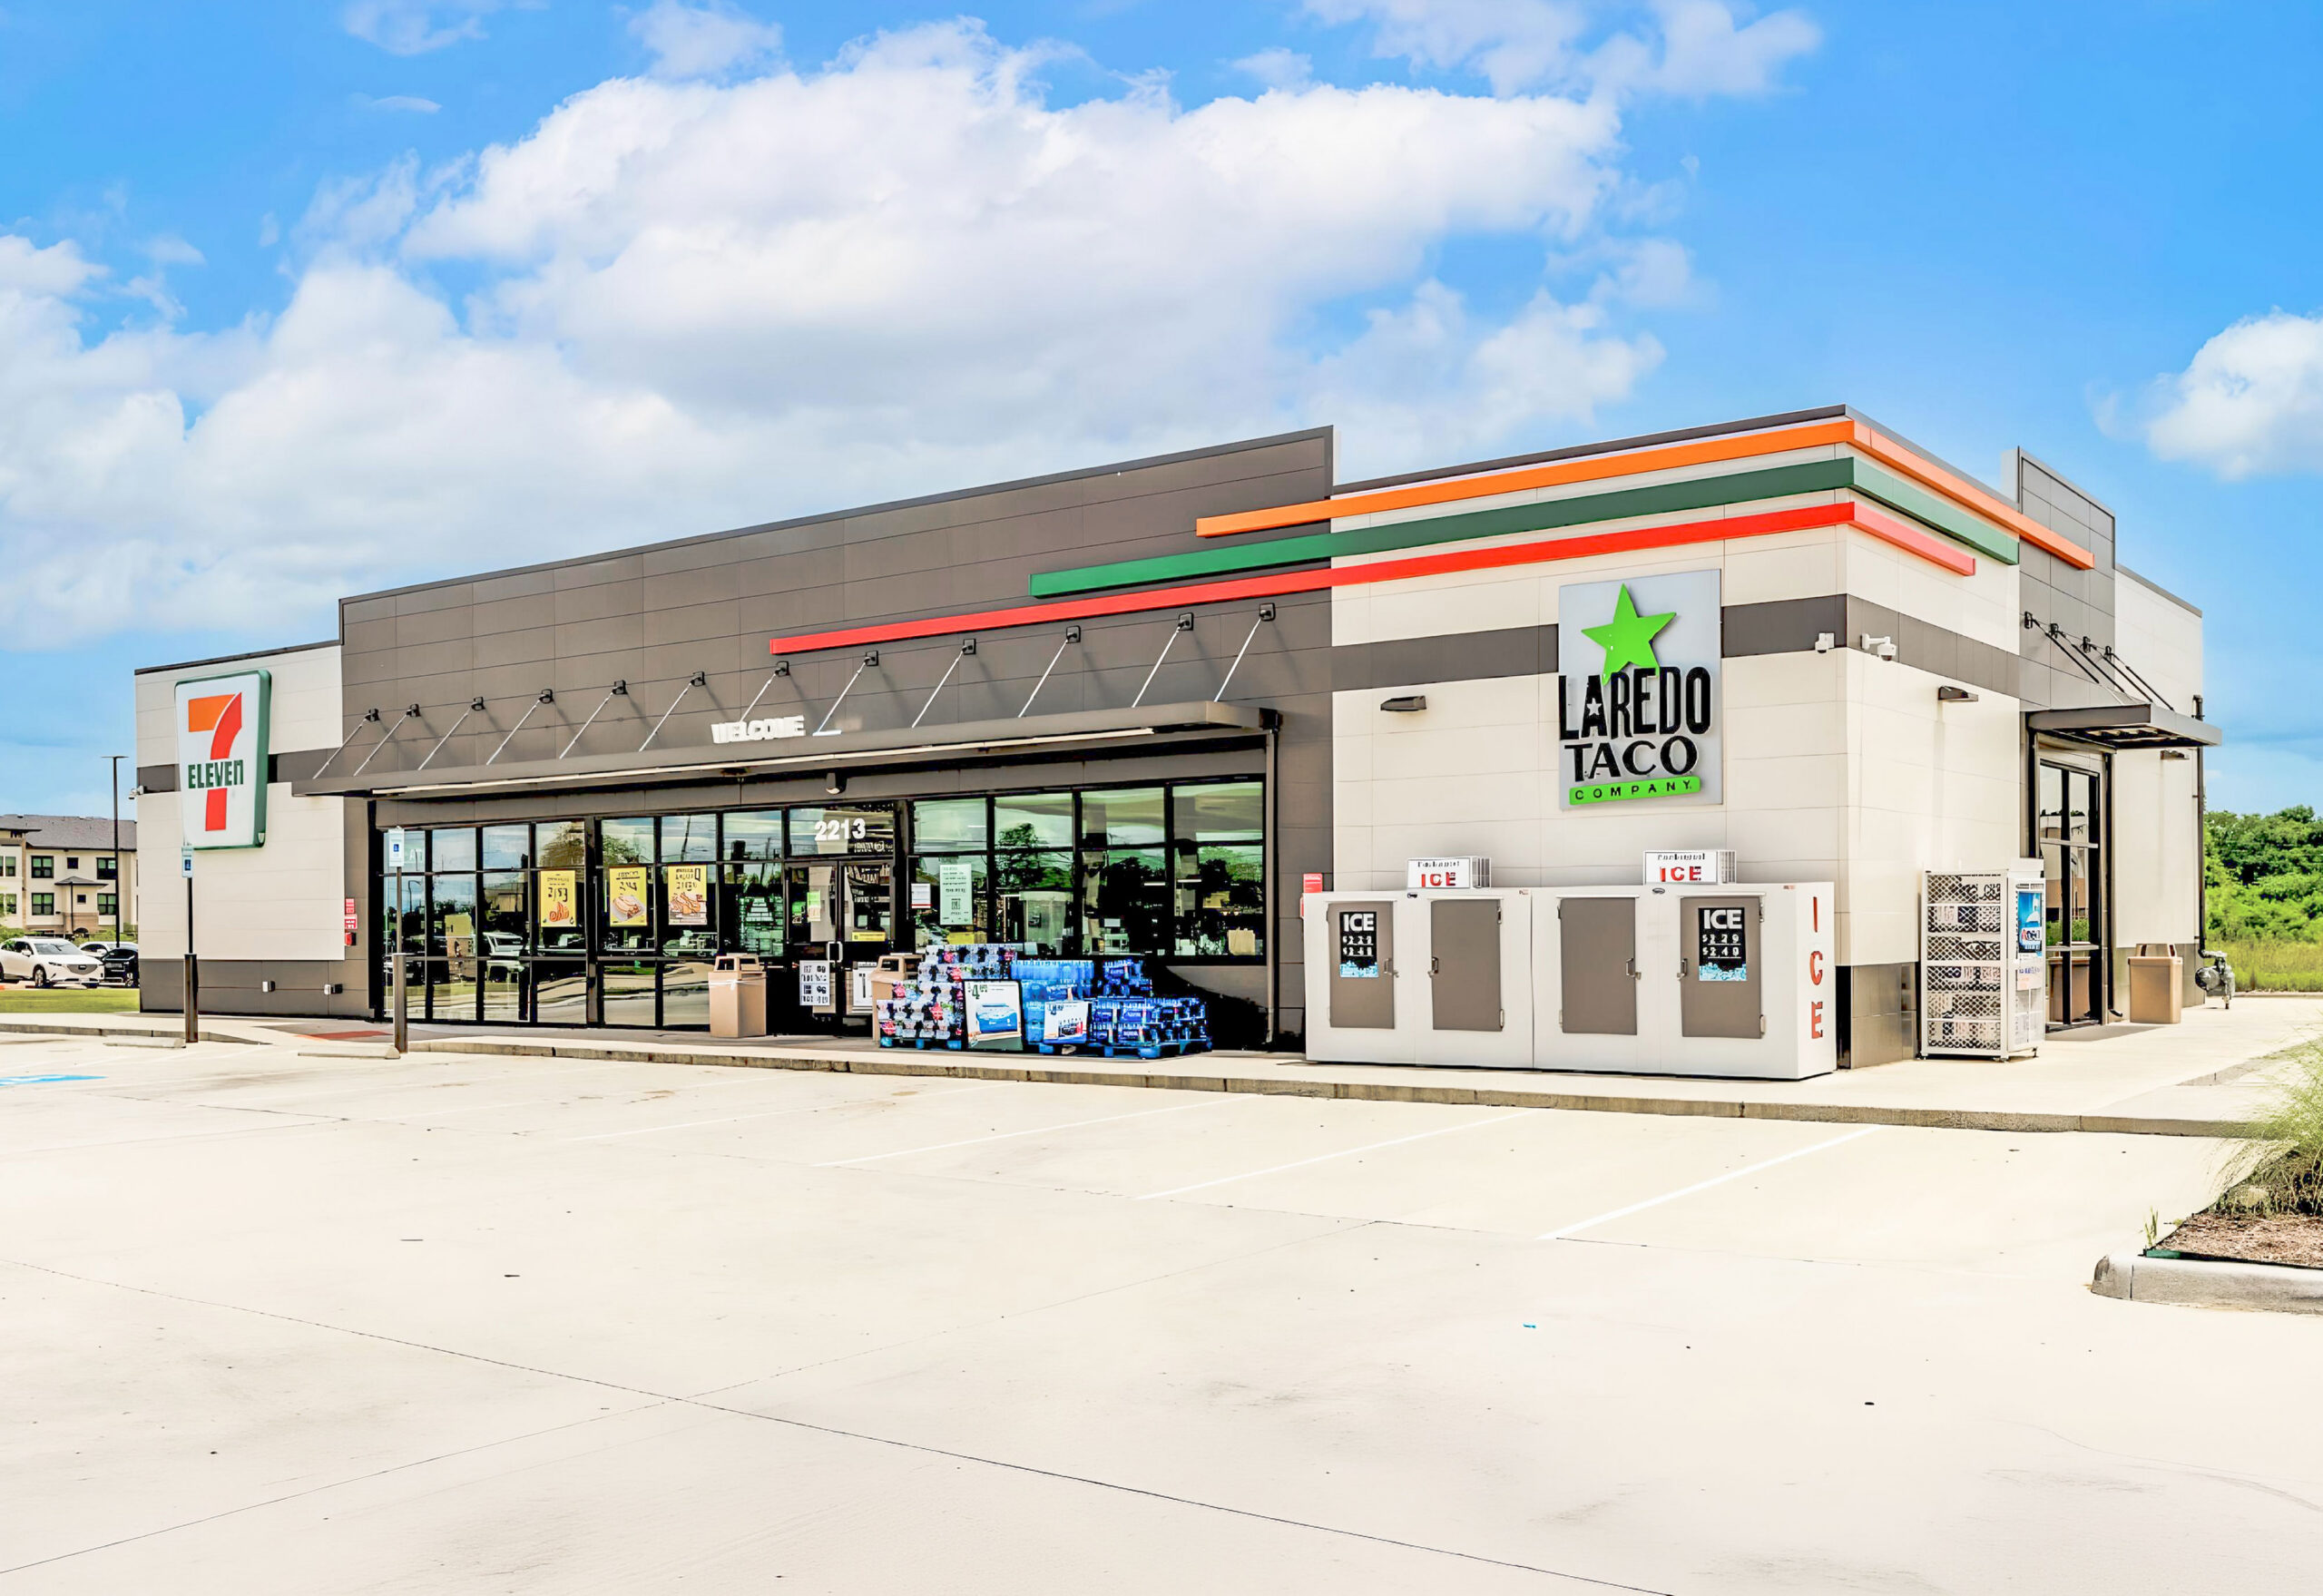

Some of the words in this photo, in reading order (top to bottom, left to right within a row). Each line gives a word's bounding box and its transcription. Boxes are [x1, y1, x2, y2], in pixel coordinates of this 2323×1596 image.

[1558, 666, 1711, 740] LAREDO
[188, 691, 242, 831] 7
[1563, 735, 1698, 782] TACO
[1574, 778, 1692, 800] COMPANY
[814, 818, 867, 841] 2213
[1421, 871, 1456, 888] ICE
[1659, 866, 1702, 883] ICE
[1343, 913, 1375, 933] ICE
[1703, 909, 1743, 930] ICE
[1809, 896, 1824, 1040] ICE
